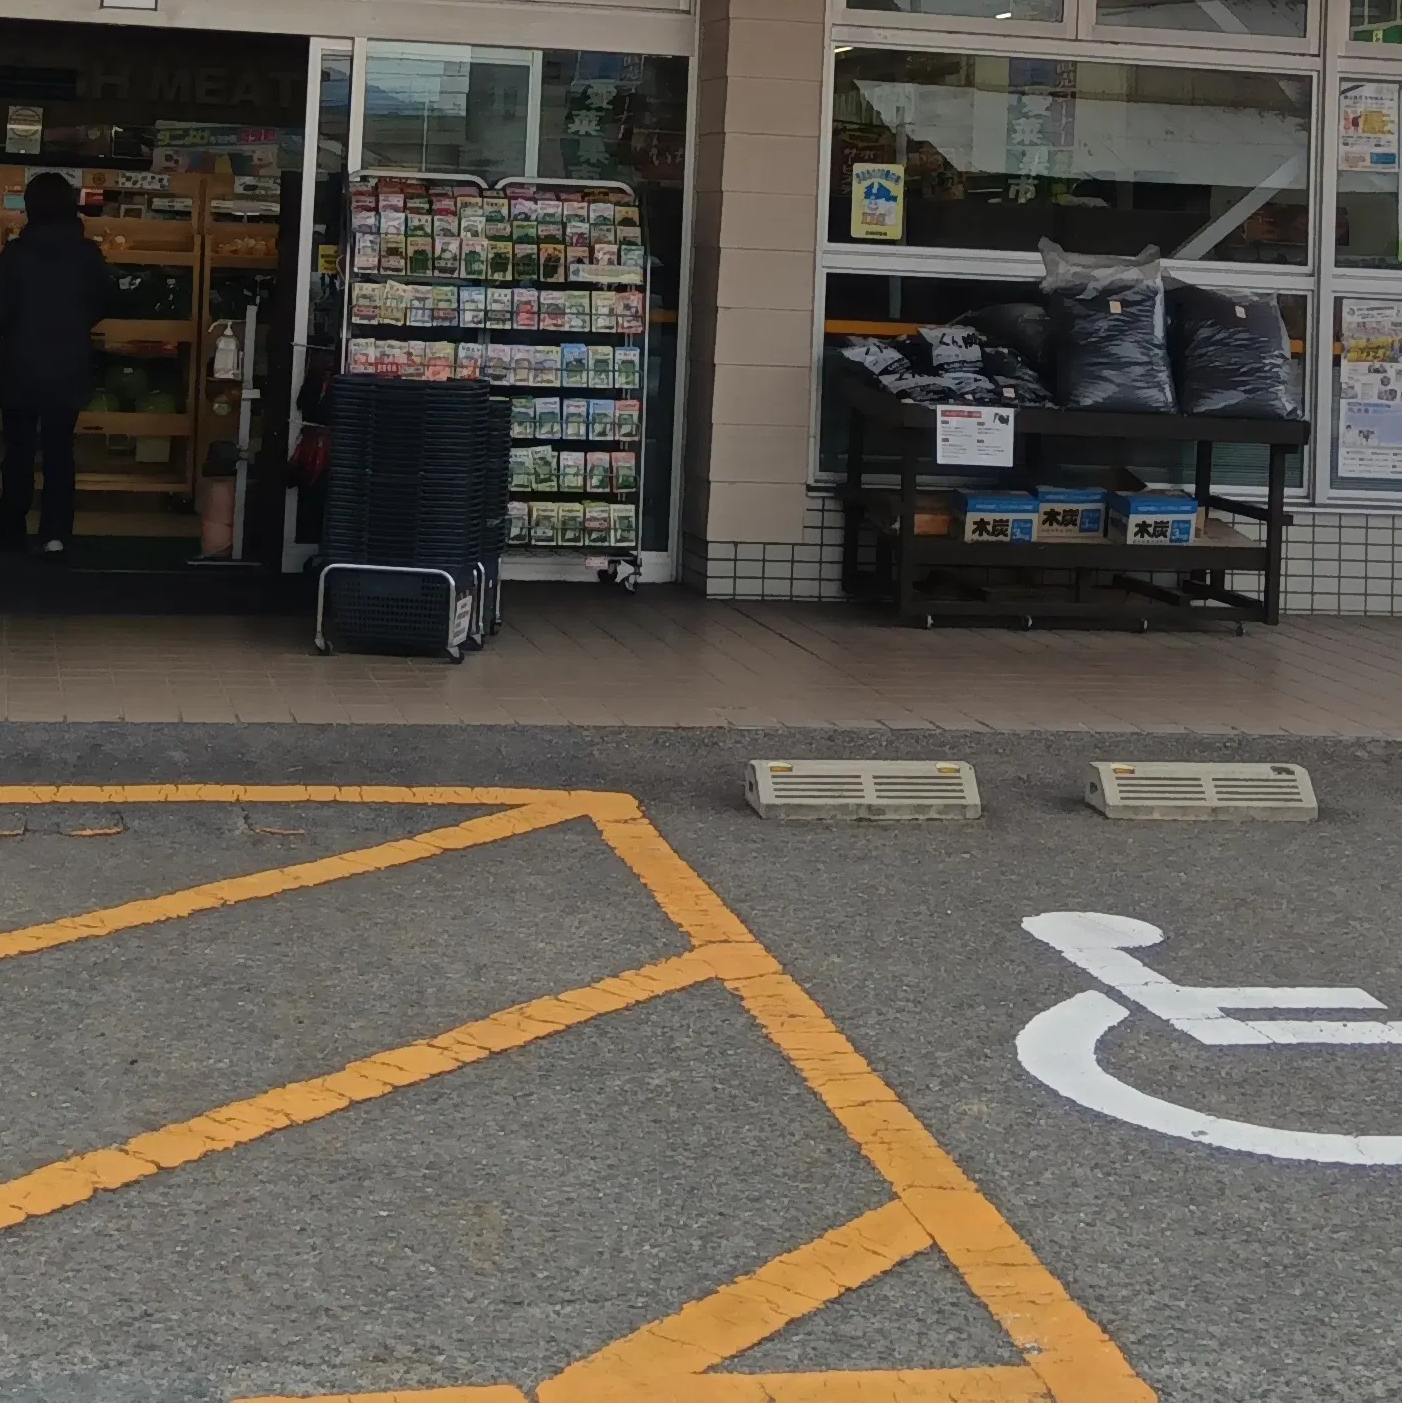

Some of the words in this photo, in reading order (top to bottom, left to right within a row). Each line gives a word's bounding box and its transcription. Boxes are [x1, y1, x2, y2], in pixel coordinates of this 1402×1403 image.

[149, 65, 306, 109] MEAT
[971, 517, 1010, 538] 木炭
[1042, 508, 1080, 527] 木炭
[1133, 520, 1170, 539] 木炭
